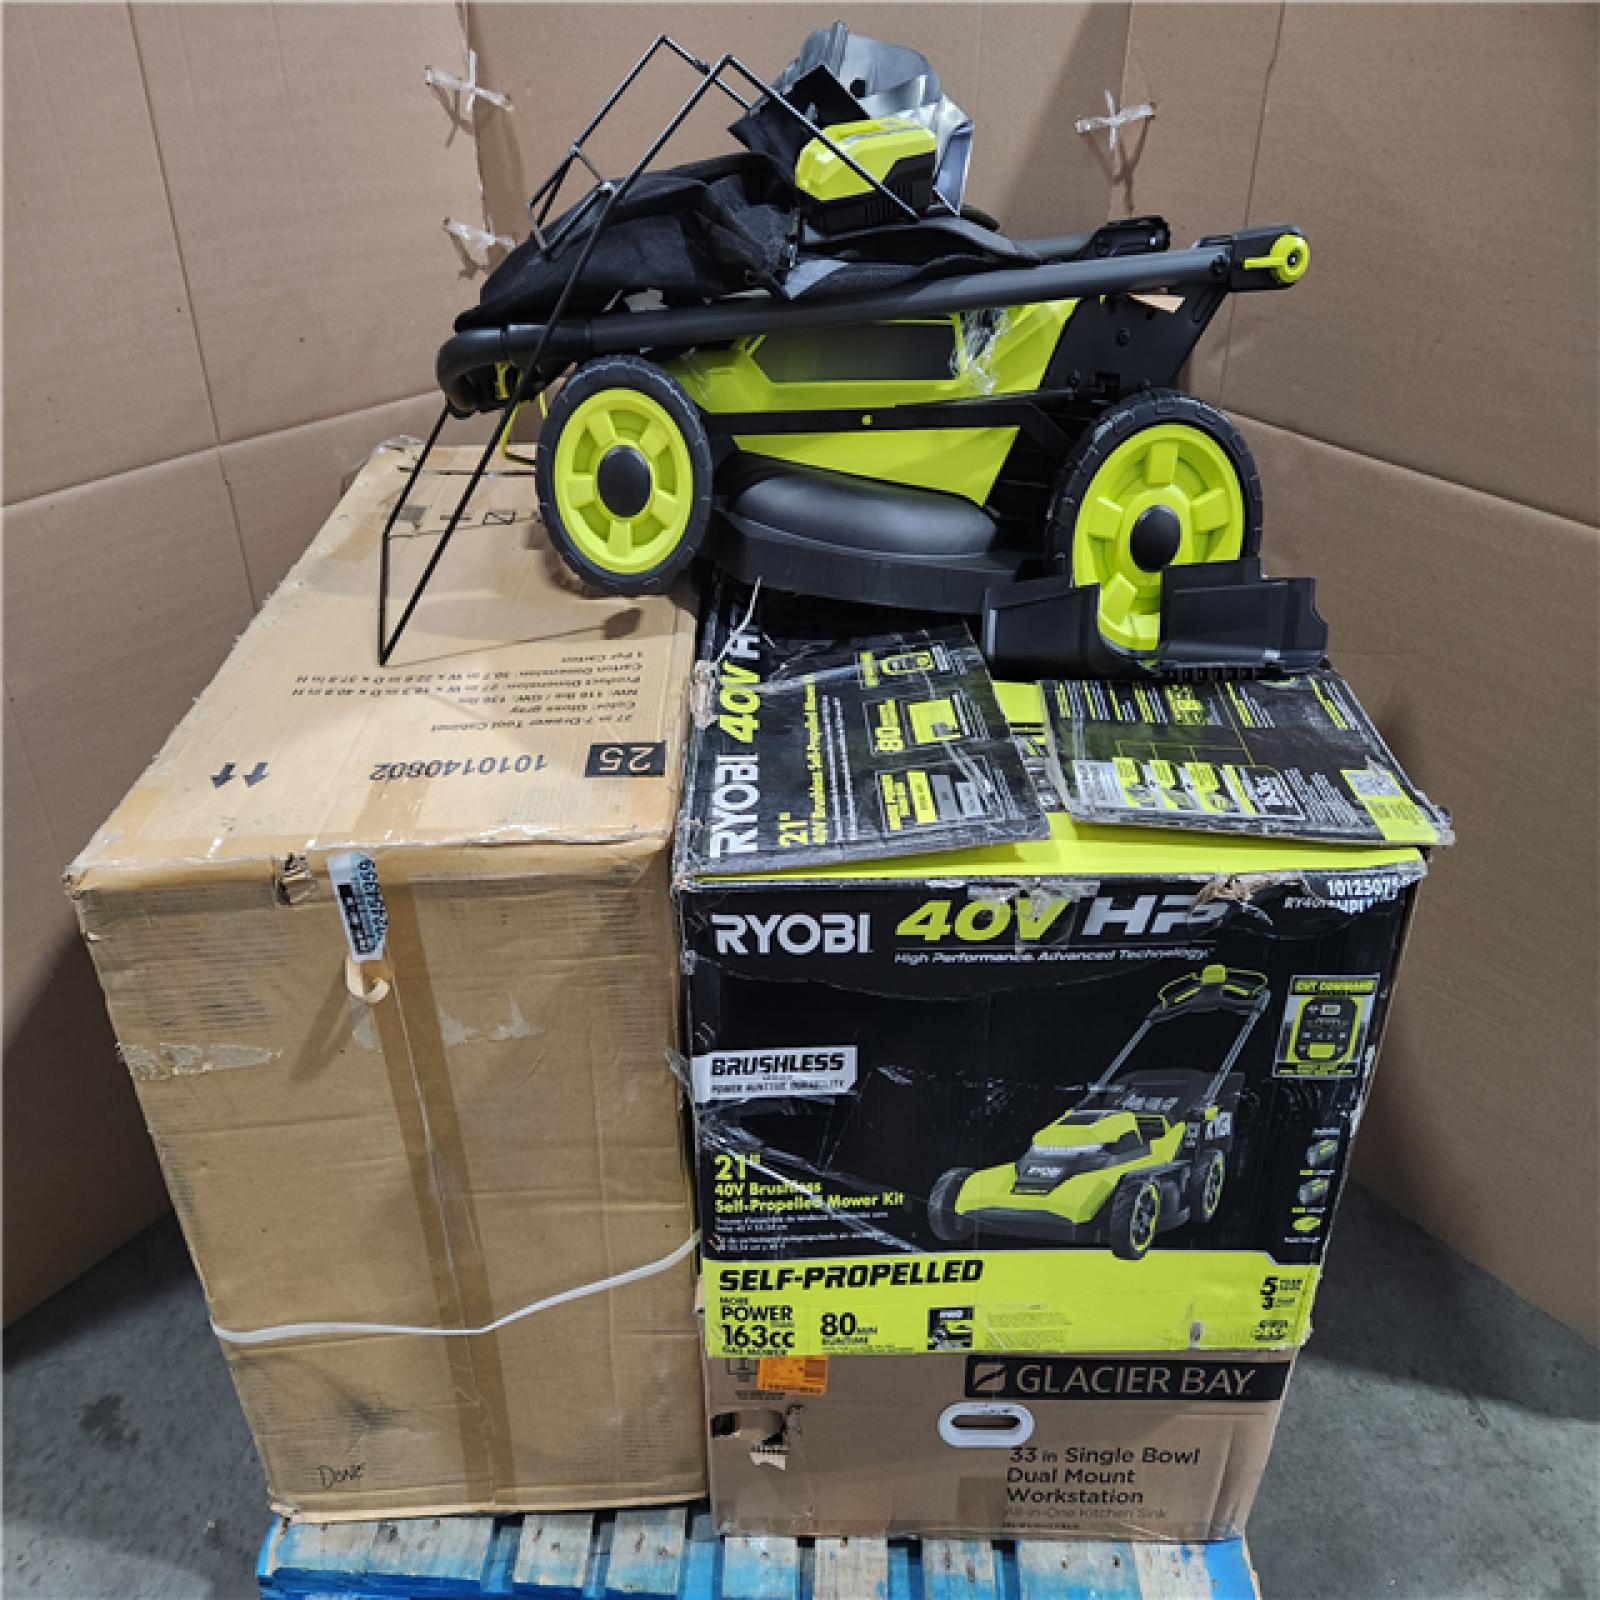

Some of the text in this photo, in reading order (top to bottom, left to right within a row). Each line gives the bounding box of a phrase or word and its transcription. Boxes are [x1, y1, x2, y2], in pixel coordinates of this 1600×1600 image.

[717, 660, 761, 744] 40V
[874, 726, 904, 751] 80
[369, 753, 548, 783] 1010140802
[597, 745, 655, 773] 25
[709, 755, 759, 858] RYOBI
[711, 894, 1229, 955] RYOBI 40V HP
[894, 951, 929, 966] High
[931, 951, 1035, 963] Performance
[1039, 950, 1116, 961] Advanced
[711, 1051, 846, 1077] BRUSHLESS
[714, 1153, 760, 1181] 21"
[714, 1182, 745, 1196] 40V
[714, 1191, 904, 1214] Self-Propelled Mower Kit
[718, 1259, 984, 1291] SELF-PROPELLED
[1260, 1276, 1278, 1295] 5
[721, 1304, 794, 1322] POWER
[1262, 1295, 1274, 1310] 3
[821, 1311, 857, 1336] 80
[721, 1324, 795, 1349] 163cc
[1016, 1364, 1257, 1396] GLACIER BAY
[1009, 1446, 1201, 1466] 33 in Single Bowl
[1006, 1466, 1136, 1484] Dual Mount
[1006, 1487, 1144, 1504] Workstation
